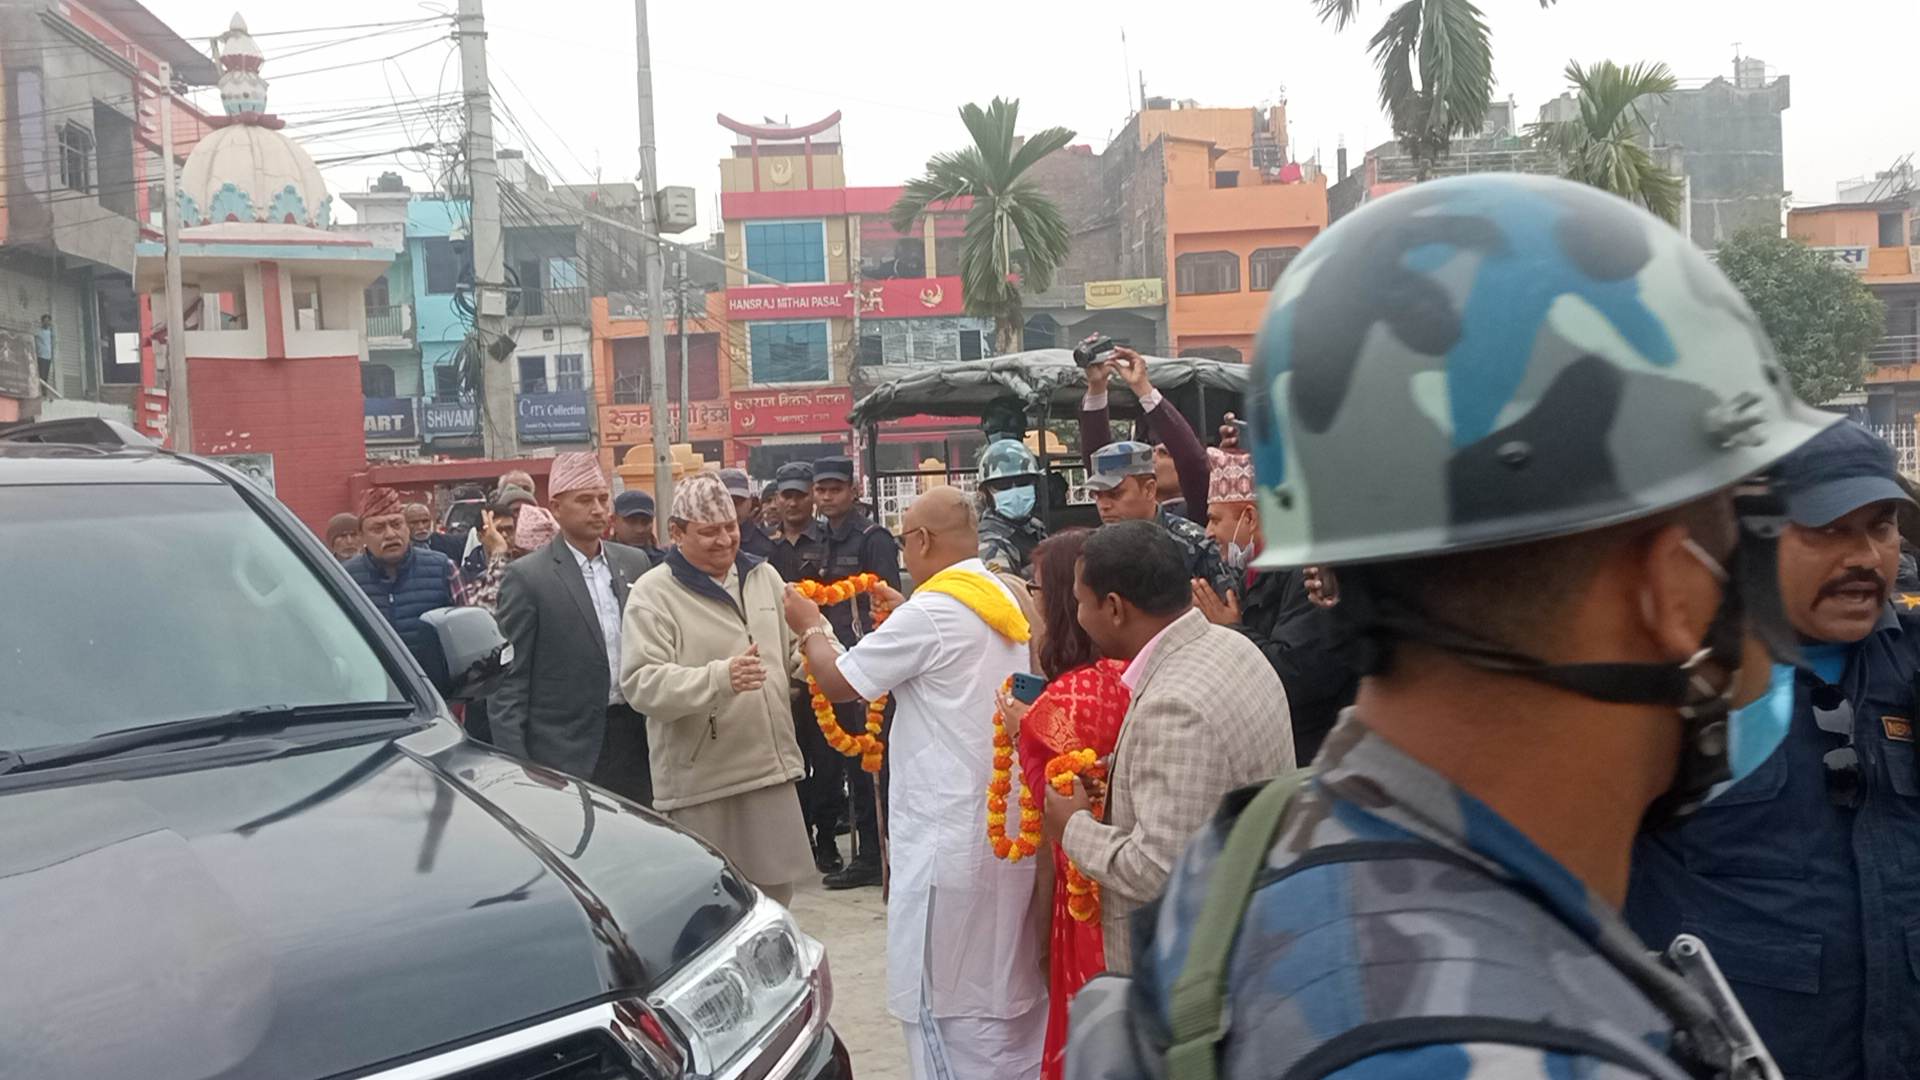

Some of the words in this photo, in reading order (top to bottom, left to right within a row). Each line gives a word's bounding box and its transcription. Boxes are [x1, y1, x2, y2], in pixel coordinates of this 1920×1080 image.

[729, 297, 775, 311] HANSRAJ
[777, 296, 809, 309] MITHAI
[811, 295, 841, 308] PASAL
[547, 404, 586, 416] Collection
[427, 410, 475, 428] SHIVAM
